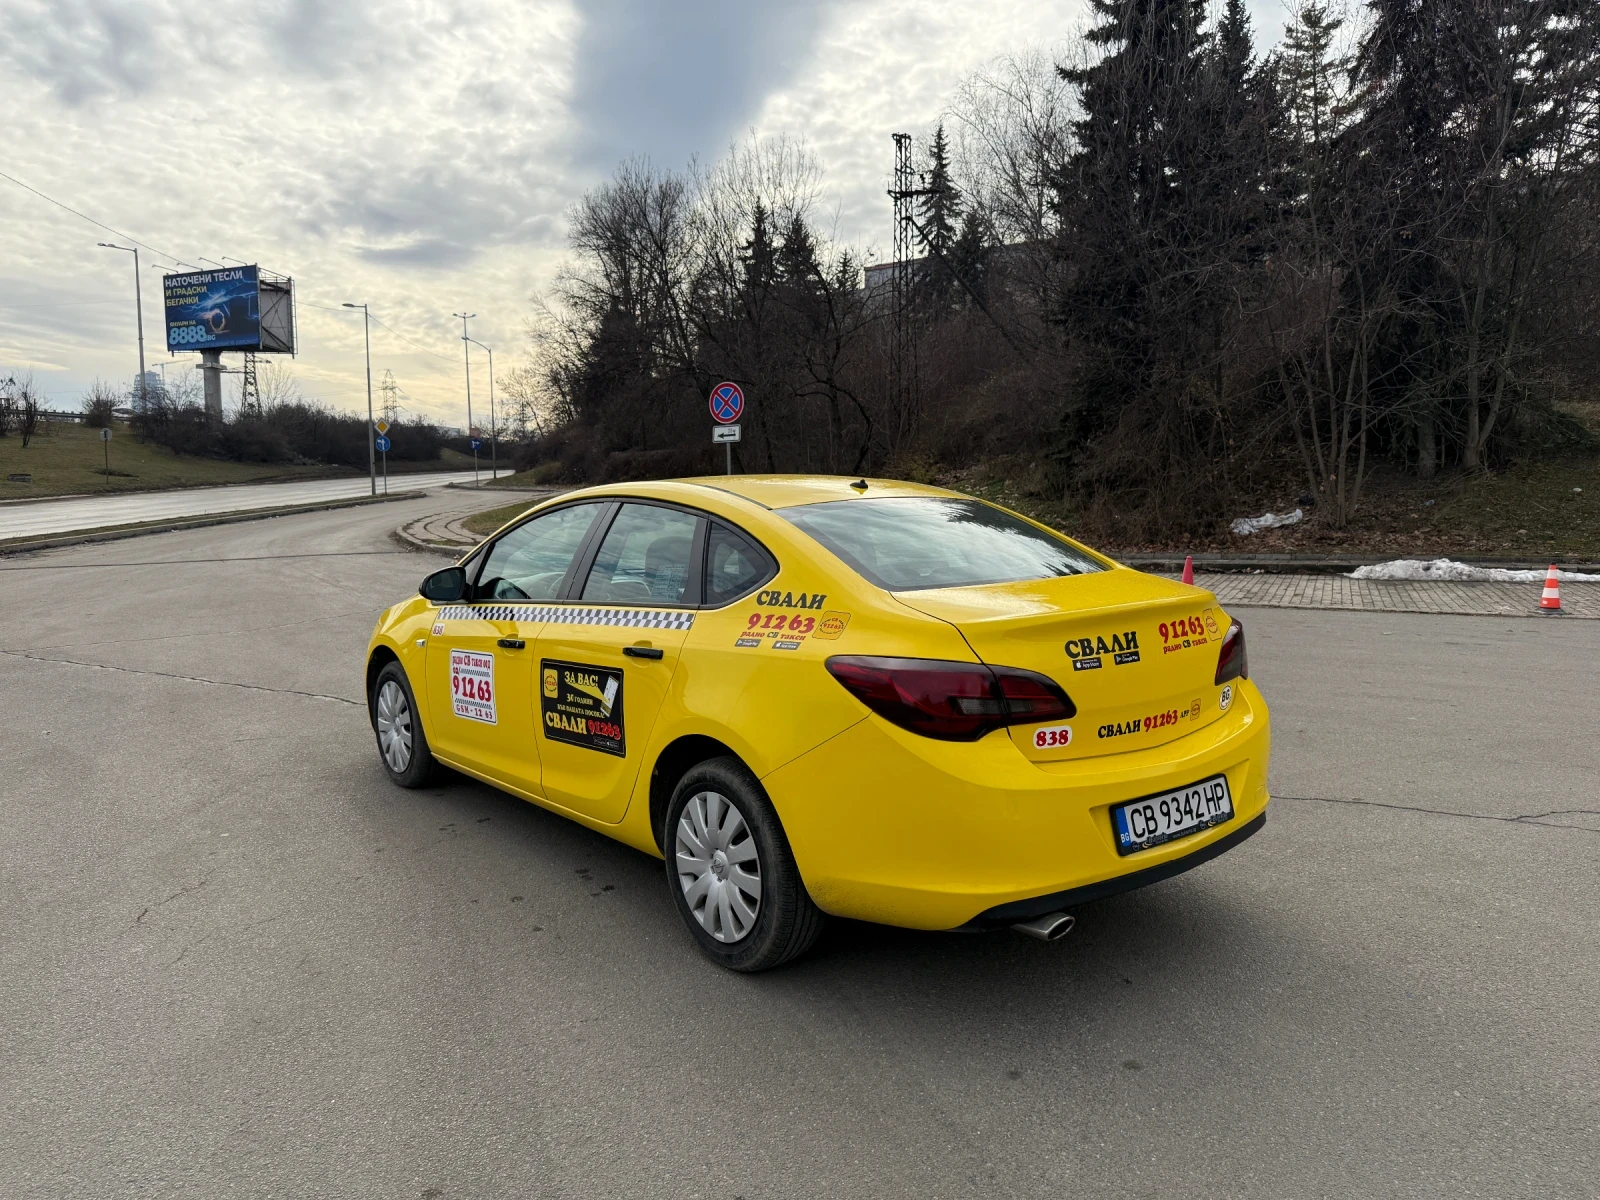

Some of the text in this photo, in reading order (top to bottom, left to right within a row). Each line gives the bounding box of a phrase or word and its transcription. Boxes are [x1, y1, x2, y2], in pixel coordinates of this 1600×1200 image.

[165, 270, 243, 287] НАТОЧЕНИ ТЕСЛИ
[166, 286, 207, 297] И ГРАДСКИ
[166, 296, 199, 307] БЕГАЧКИ
[756, 590, 827, 610] СВАЛИ
[433, 625, 444, 635] 838
[740, 631, 765, 639] радио
[780, 633, 807, 641] такси
[1064, 631, 1140, 659] СВАЛИ
[1163, 643, 1182, 654] радио
[564, 671, 576, 684] ЗА
[577, 672, 599, 687] ВАС!
[1222, 688, 1230, 703] BG
[456, 704, 469, 714] GSM
[546, 711, 621, 741] СВАЛИ 91263
[1097, 719, 1141, 738] СВАЛИ
[1143, 709, 1178, 732] 91263
[1035, 730, 1070, 747] 838
[1159, 790, 1204, 829] 9342
[1120, 832, 1130, 843] BG
